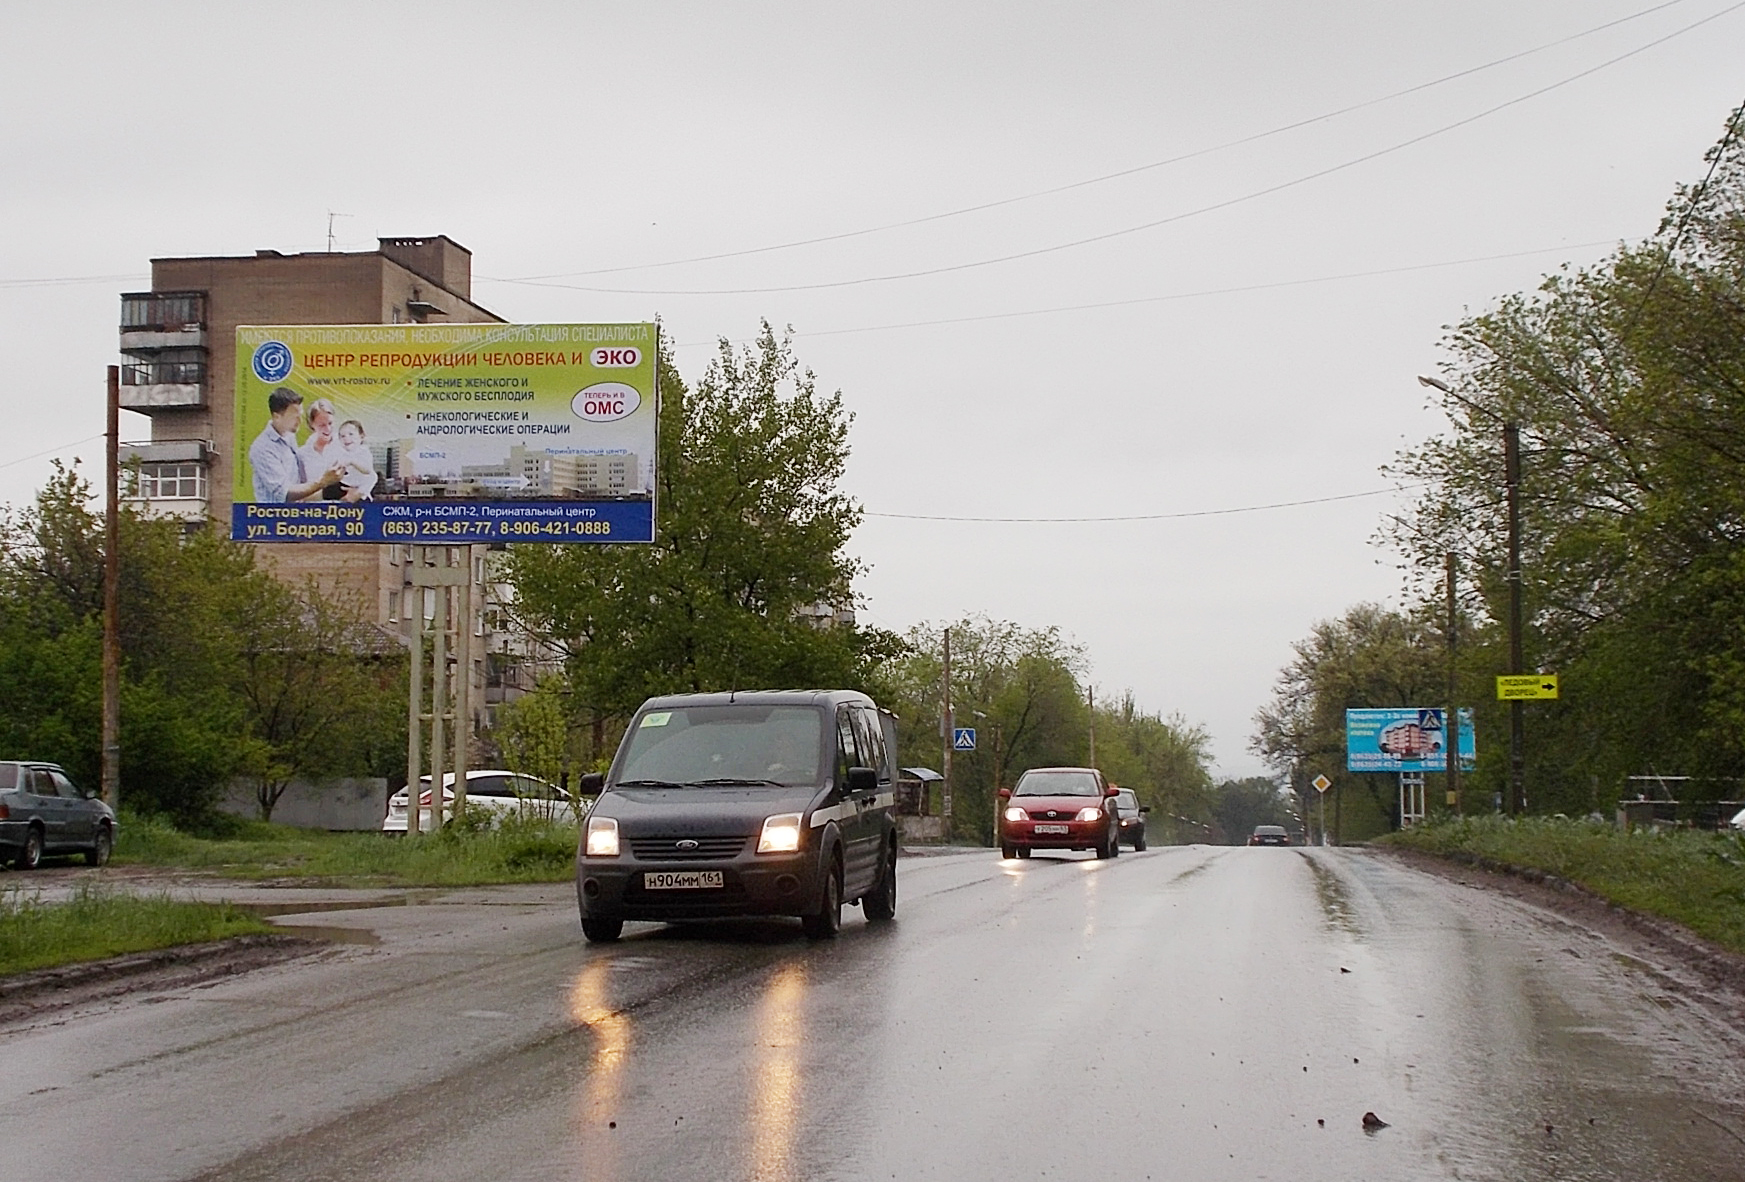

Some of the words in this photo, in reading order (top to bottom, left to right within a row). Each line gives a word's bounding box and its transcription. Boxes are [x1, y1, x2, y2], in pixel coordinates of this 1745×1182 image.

[241, 330, 294, 344] ИМЕЮТСЯ
[298, 330, 409, 345] ПРОТИВОПОКАЗАНИЯ,
[411, 328, 482, 344] НЕОБХОДИМА
[485, 327, 569, 343] КОНСУЛЬТАЦИЯ
[571, 326, 648, 342] СПЕЦИАЛИСТА
[304, 354, 355, 368] ЦЕНТР
[360, 352, 477, 368] РЕПРОДУКЦИИ
[483, 352, 567, 366] ЧЕЛОВЕКА
[572, 352, 583, 365] И
[596, 350, 637, 365] ЭКО
[307, 377, 390, 386] www.vrt-rostov.ru
[417, 378, 462, 388] ЛЕЧЕНИЕ
[465, 378, 519, 388] ЖЕНСКОГО
[521, 378, 528, 387] И
[417, 392, 472, 401] МУЖСКОГО
[474, 391, 534, 401] БЕСПЛОДИЯ
[584, 401, 625, 415] ОМС
[417, 412, 519, 421] ГИНЕКОЛОГИЧЕСКИЕ
[521, 412, 529, 421] И
[417, 425, 514, 435] АНДРОЛОГИЧЕСКИЕ
[517, 424, 570, 435] ОПЕРАЦИИ
[545, 448, 605, 456] Перинатальный
[607, 448, 627, 456] центр
[247, 505, 364, 521] Ростов-на-Дону
[382, 507, 413, 518] СЖМ,
[415, 509, 431, 518] р-н
[434, 506, 479, 517] БСМП-2,
[481, 506, 563, 517] Перинатальный
[566, 507, 596, 518] центр
[247, 525, 271, 538] ул.
[276, 522, 340, 538] Бодрая,
[346, 522, 364, 535] 90
[382, 522, 418, 537] (863)
[422, 521, 496, 536] 235-87-77,
[500, 521, 611, 535] 8-906-421-0888
[701, 872, 721, 882] 161
